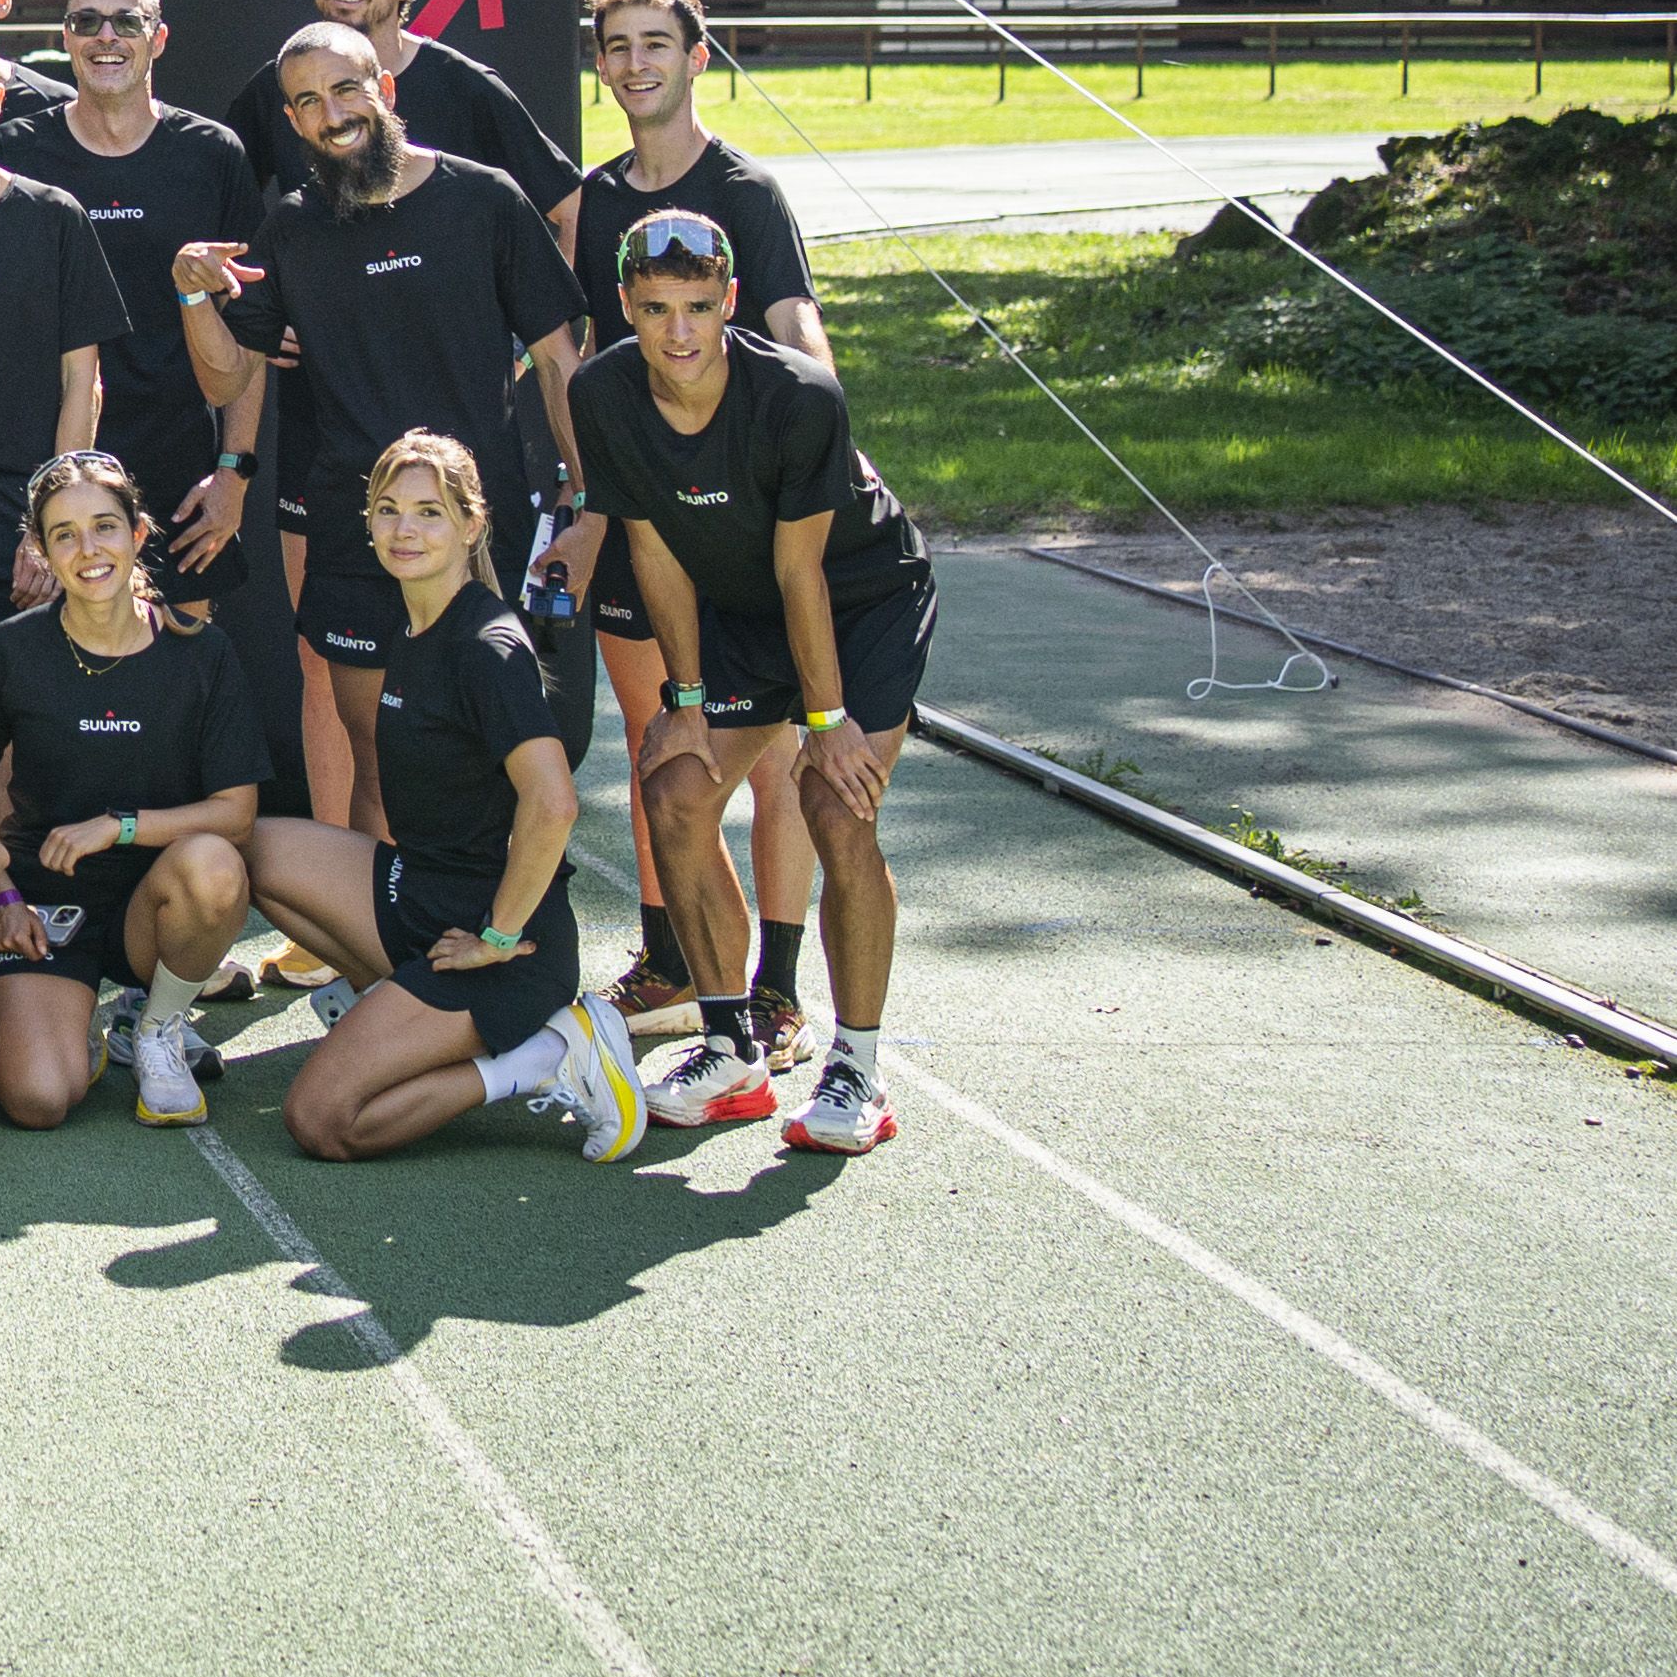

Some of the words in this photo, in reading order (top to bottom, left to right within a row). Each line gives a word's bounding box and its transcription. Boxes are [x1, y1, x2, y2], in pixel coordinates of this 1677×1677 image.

[89, 208, 144, 220] SUUNTO
[365, 255, 422, 274] SUUNTO
[599, 604, 633, 620] SUUNTO
[326, 632, 377, 652] SUUNTO
[79, 720, 141, 732] SUUNTO
